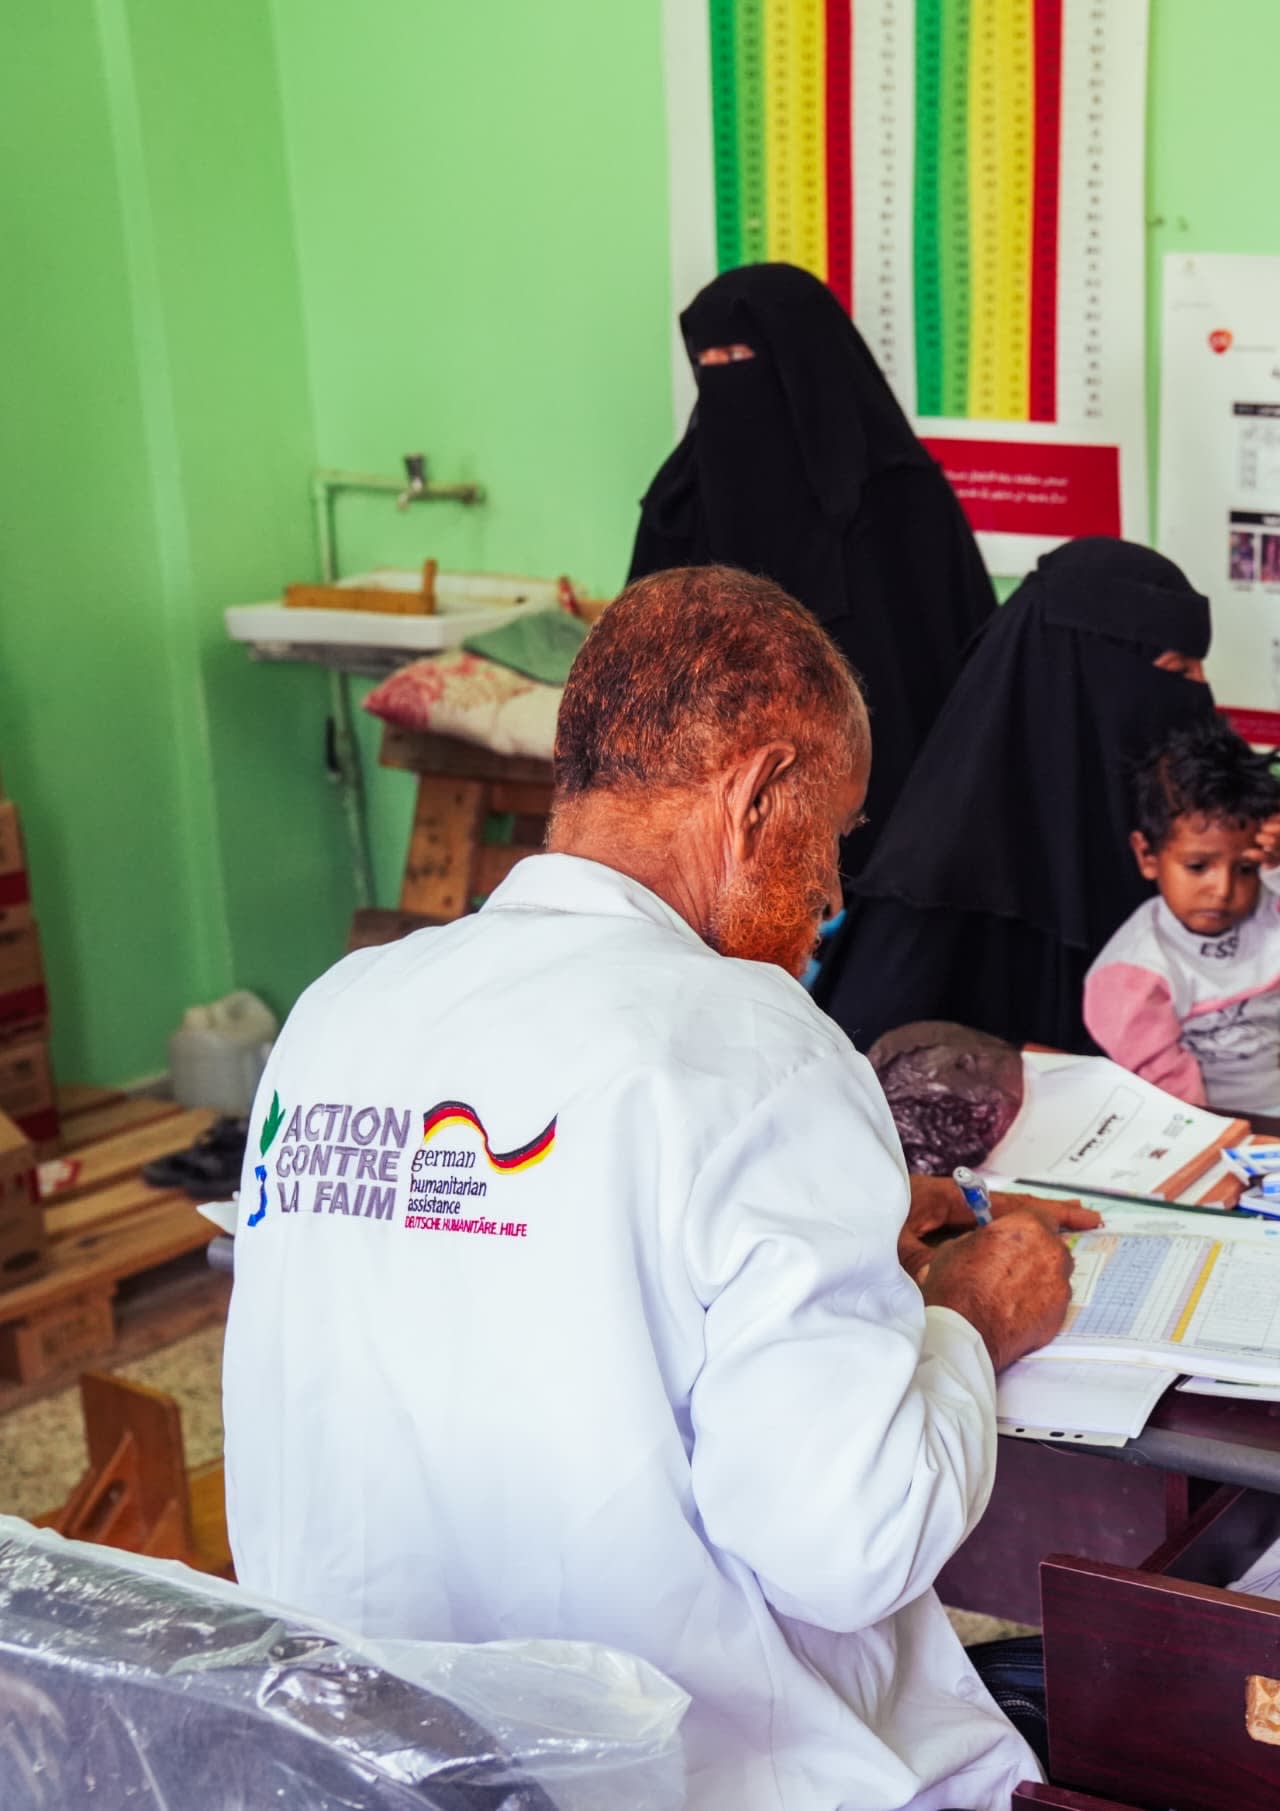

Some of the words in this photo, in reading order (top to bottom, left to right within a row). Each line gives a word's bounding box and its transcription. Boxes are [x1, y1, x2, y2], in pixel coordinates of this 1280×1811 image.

[282, 1103, 411, 1149] ACTION
[276, 1144, 401, 1182] CONTRE
[411, 1149, 476, 1172] german
[409, 1173, 487, 1197] humanitarian
[312, 1181, 397, 1220] FAIM
[407, 1194, 461, 1214] assistance
[404, 1215, 441, 1231] DEUTSCHE
[500, 1223, 527, 1237] HILFE
